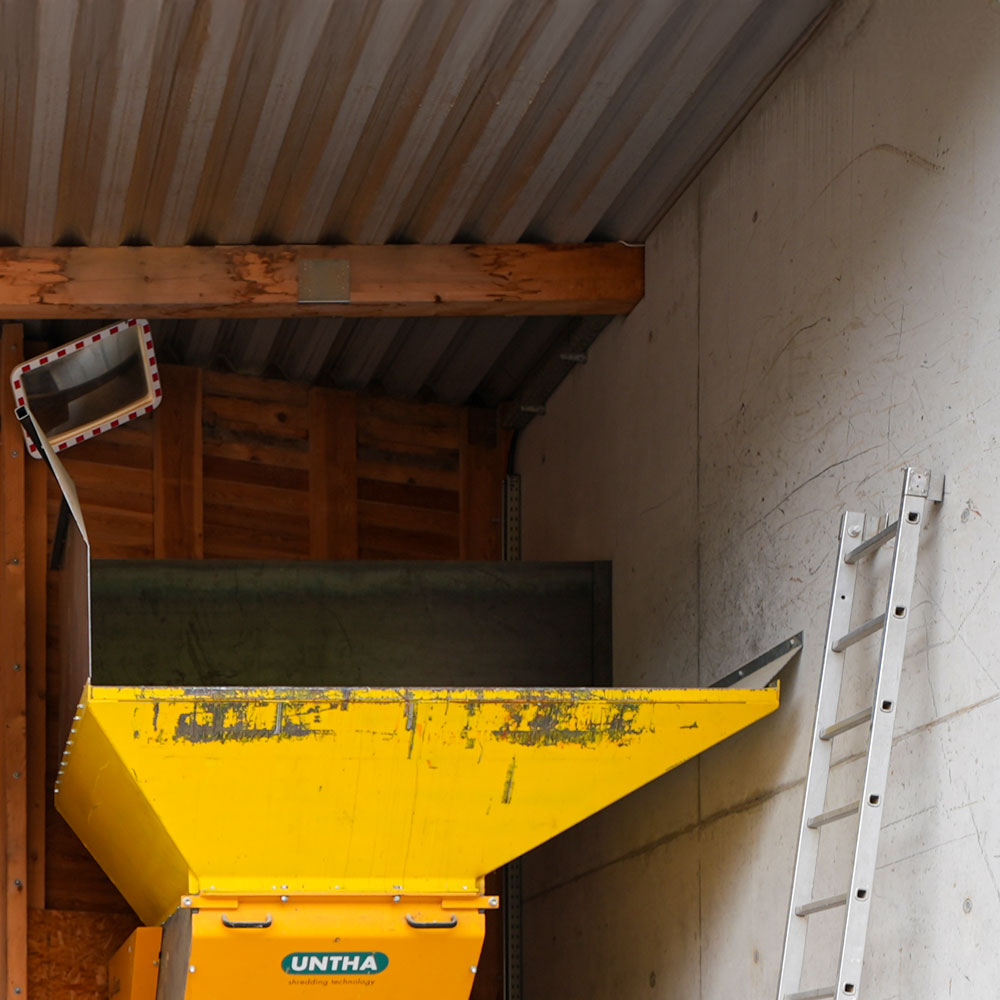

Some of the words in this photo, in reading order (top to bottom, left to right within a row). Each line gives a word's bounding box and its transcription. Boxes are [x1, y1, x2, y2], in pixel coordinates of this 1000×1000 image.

[291, 955, 378, 971] UNTHA
[288, 978, 328, 986] shredding
[331, 978, 375, 986] technology
